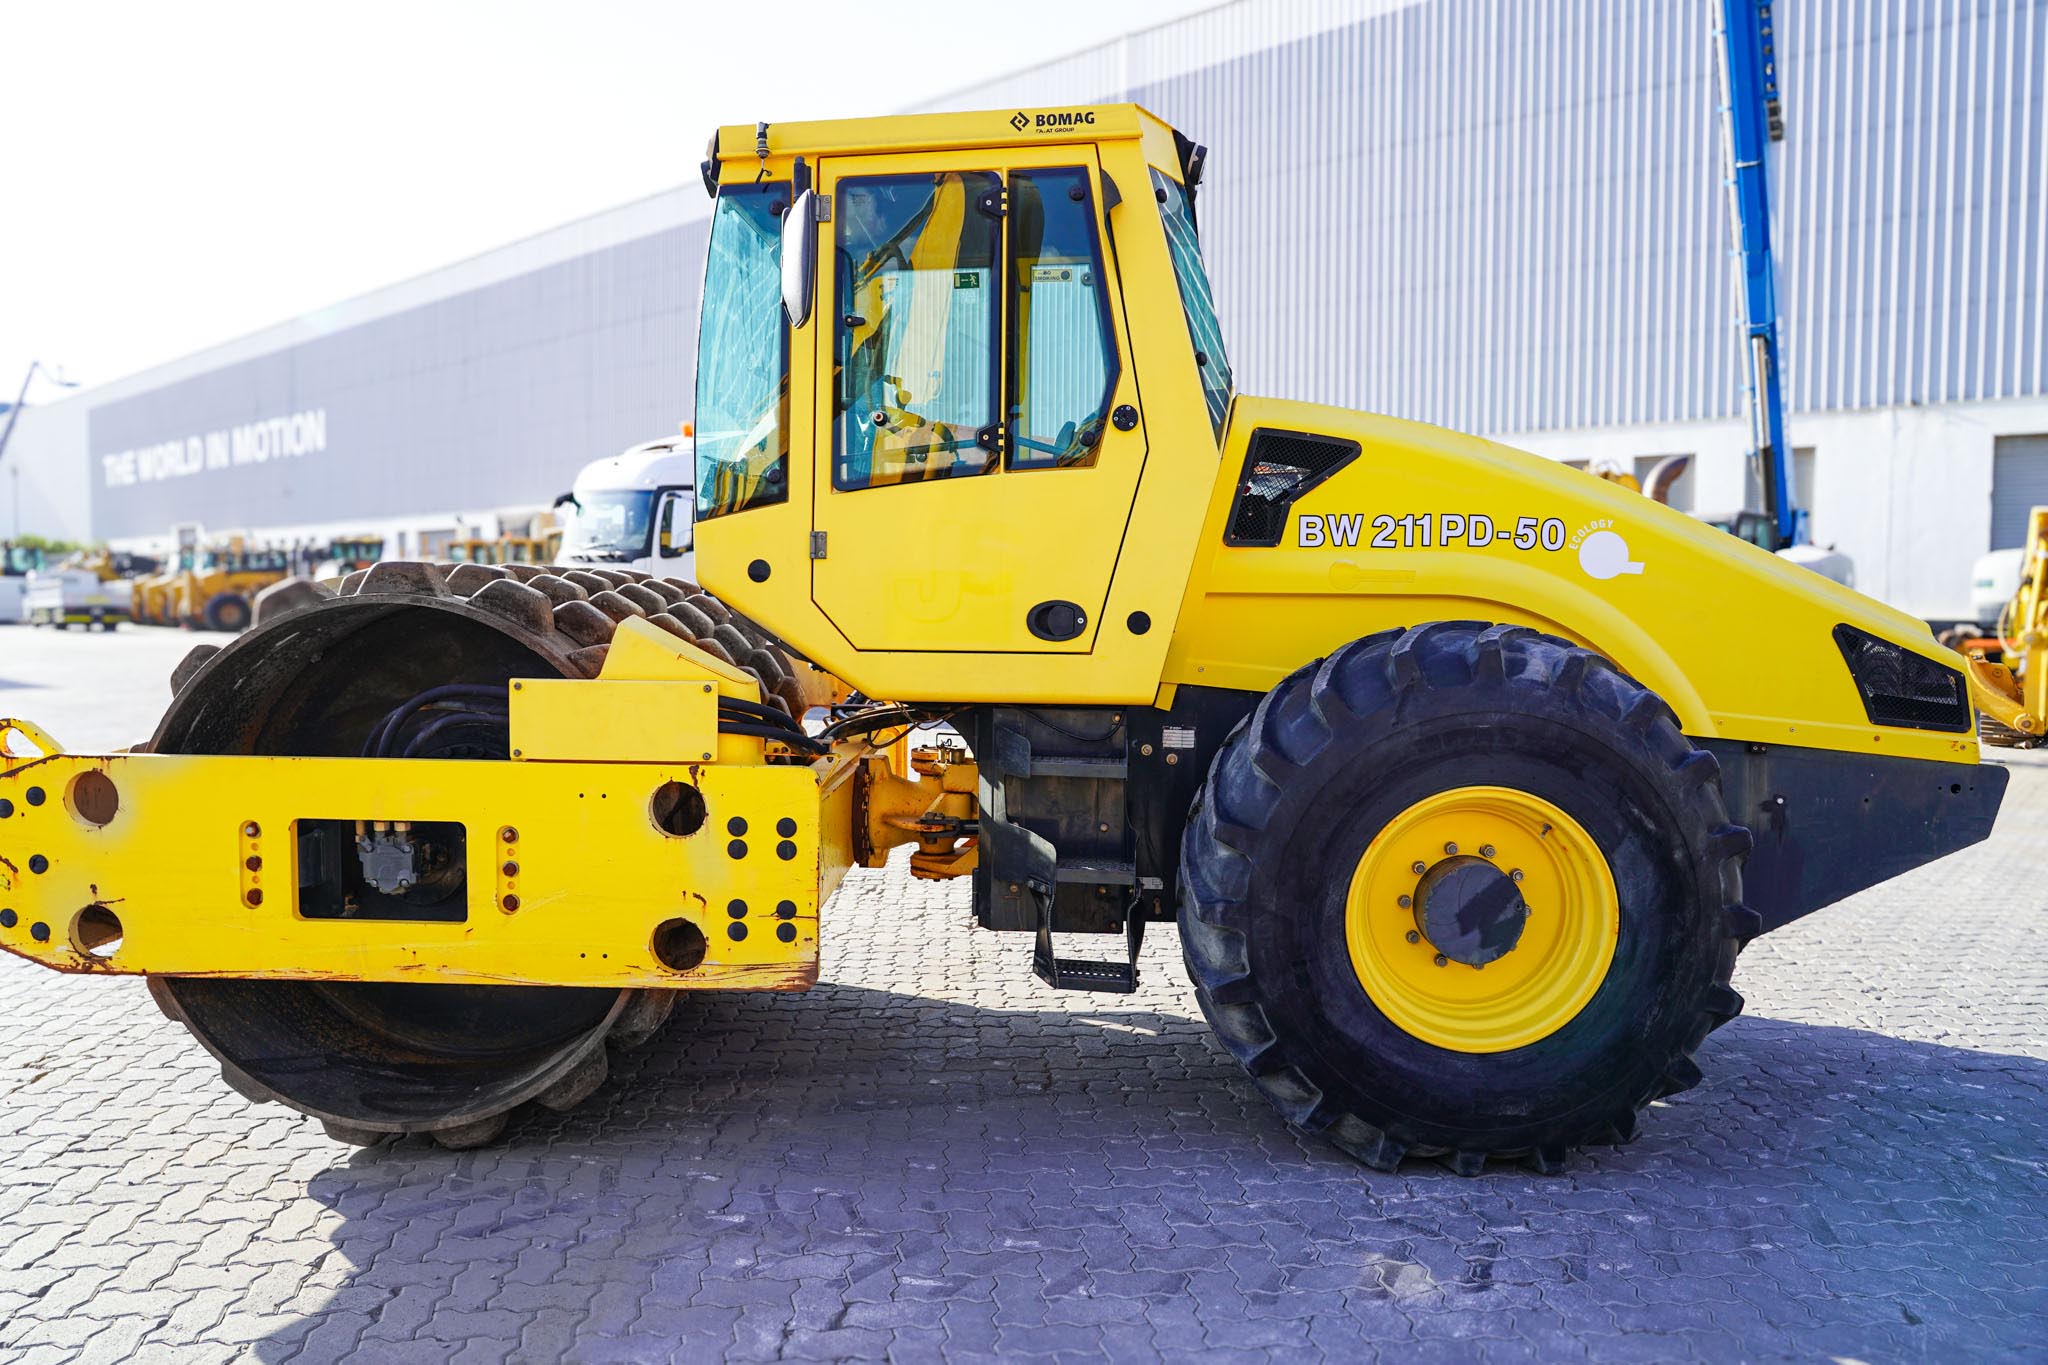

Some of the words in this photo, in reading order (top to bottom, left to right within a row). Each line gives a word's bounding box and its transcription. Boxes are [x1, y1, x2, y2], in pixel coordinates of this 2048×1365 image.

[1035, 112, 1095, 126] BOMAG
[103, 451, 137, 488] THE
[137, 436, 203, 482] WORLD
[205, 430, 230, 470] IN
[231, 409, 326, 466] MOTION
[1298, 513, 1364, 547] BW
[1370, 513, 1432, 548] 211
[1439, 514, 1567, 551] PD-50
[1568, 519, 1614, 550] ECOLOGY
